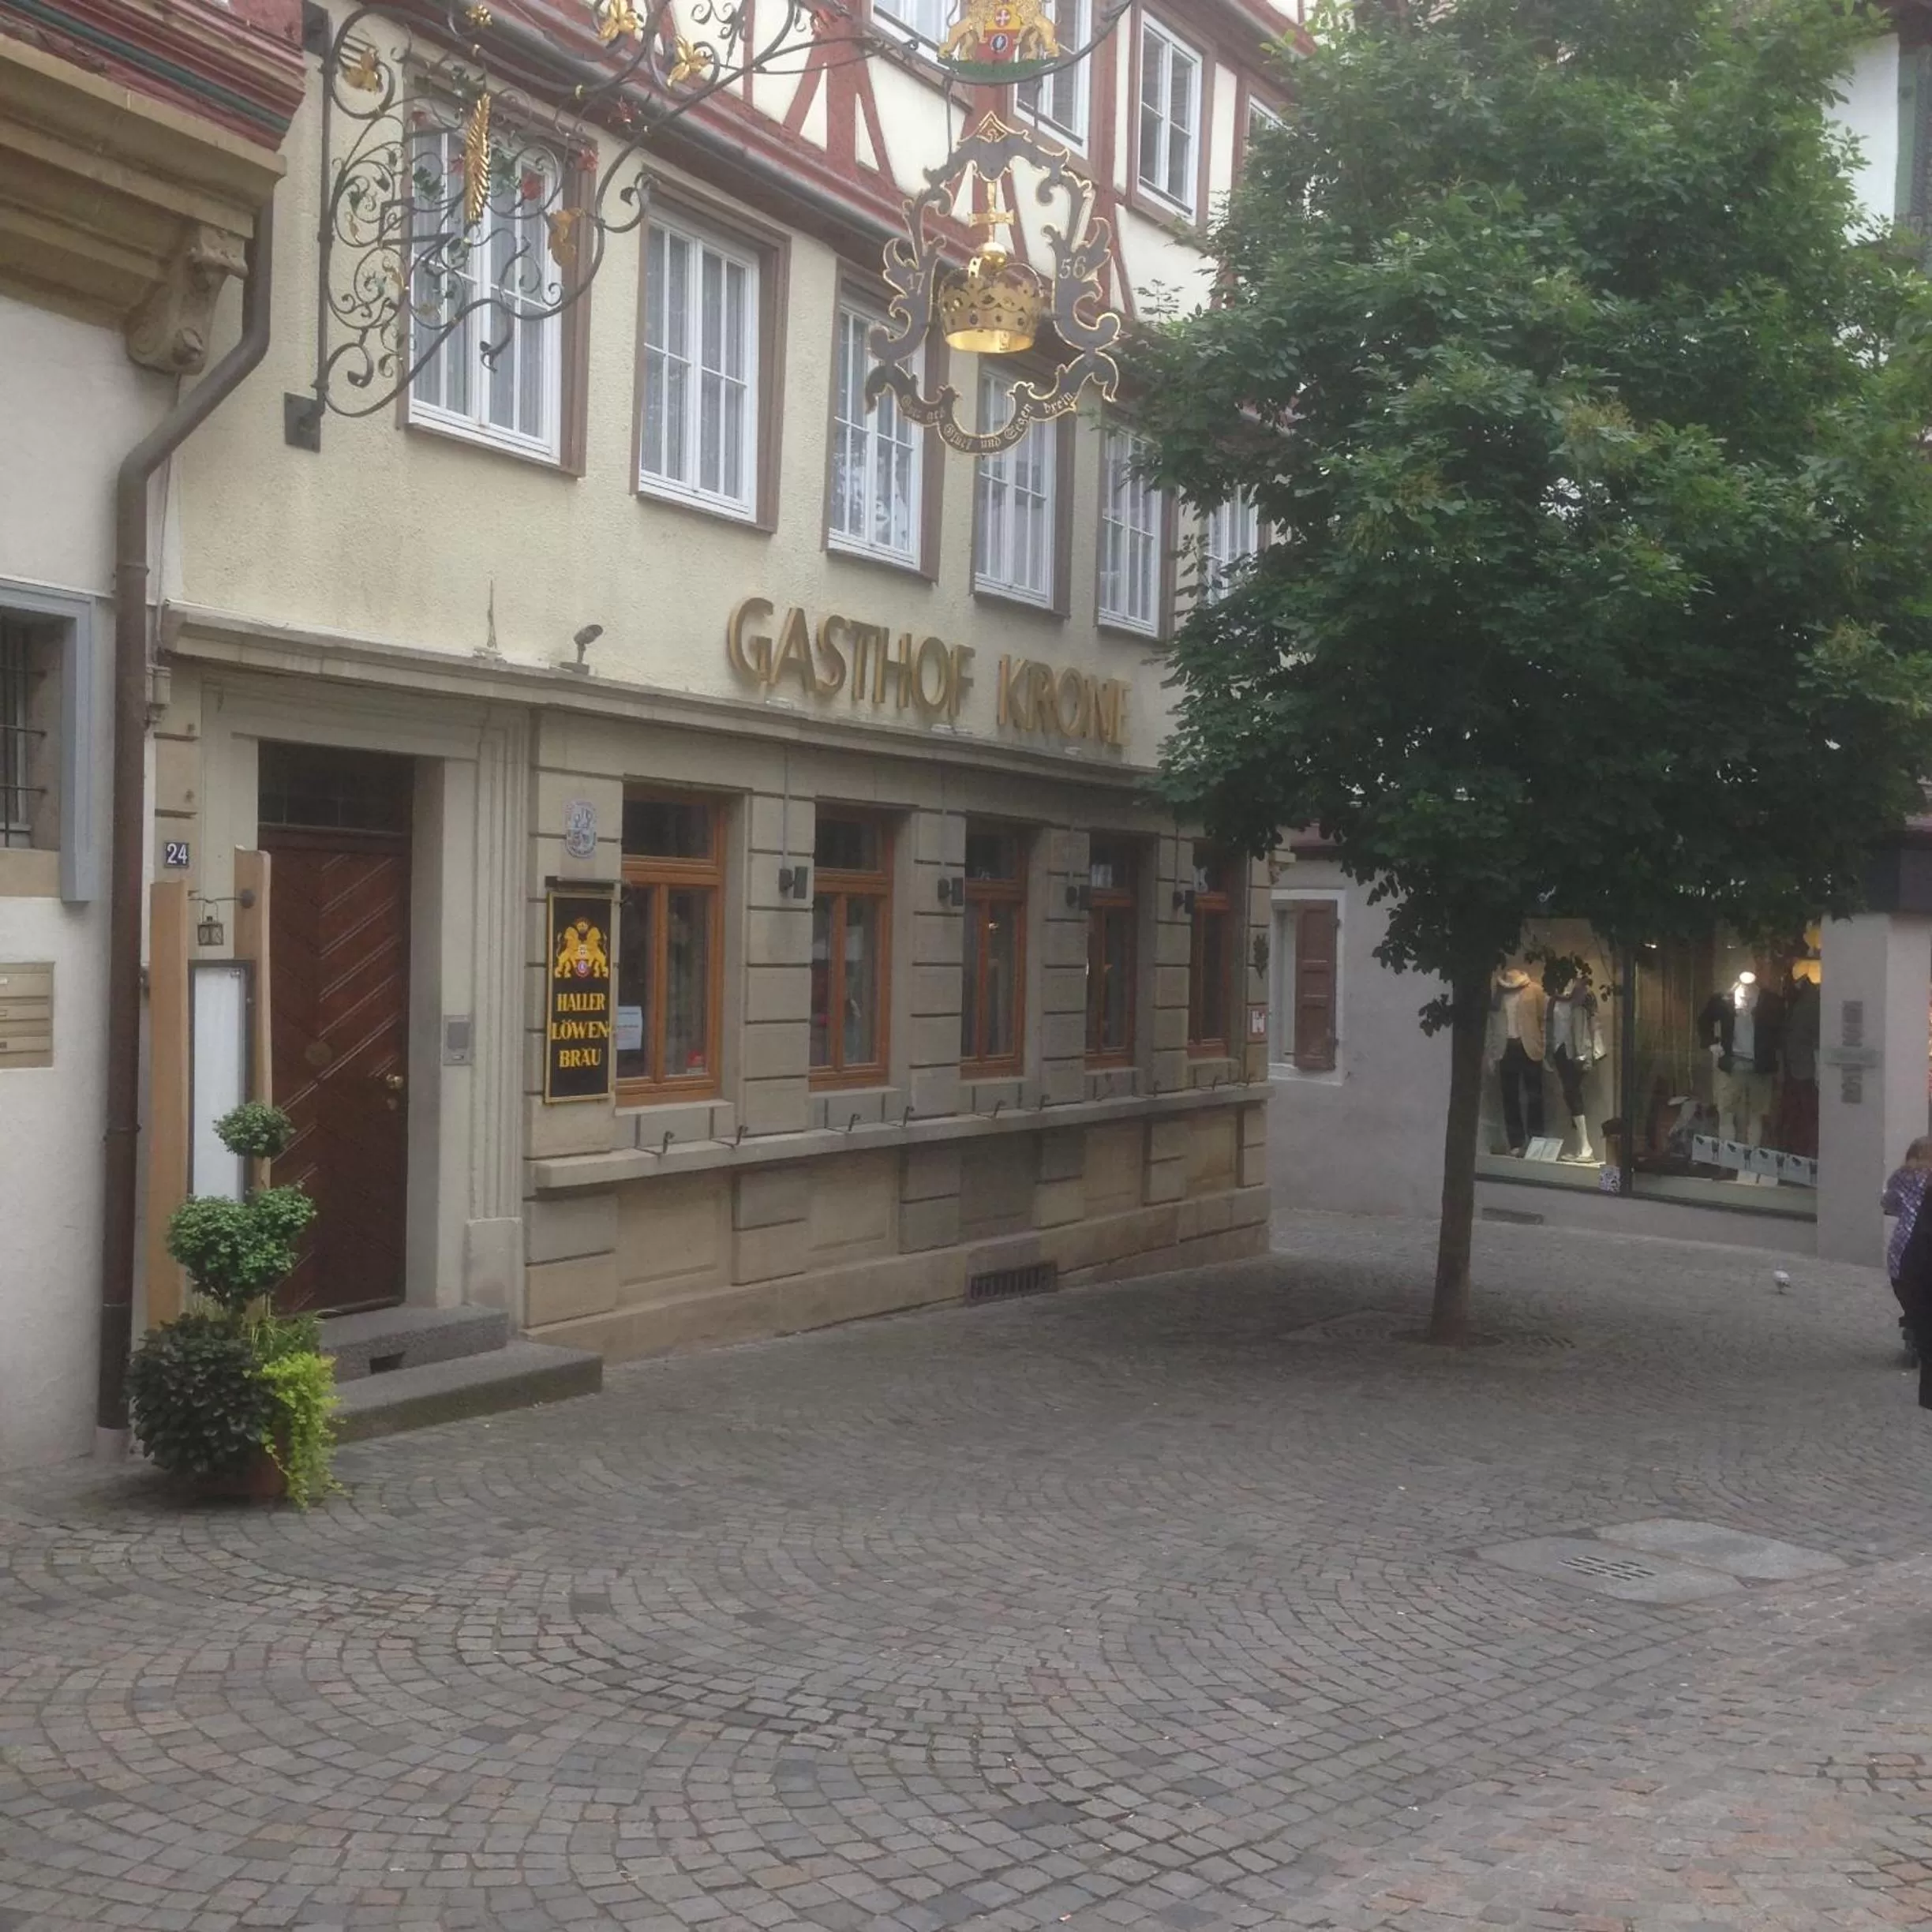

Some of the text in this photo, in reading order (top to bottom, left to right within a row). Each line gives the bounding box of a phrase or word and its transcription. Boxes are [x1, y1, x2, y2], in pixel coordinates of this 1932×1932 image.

[1059, 256, 1086, 279] 56
[980, 436, 1002, 449] und
[1004, 403, 1033, 440] Segen
[728, 597, 1132, 747] GASTHOF KRONE
[167, 843, 187, 864] 24
[556, 993, 605, 1012] HALLER
[559, 1048, 601, 1068] BRÄU
